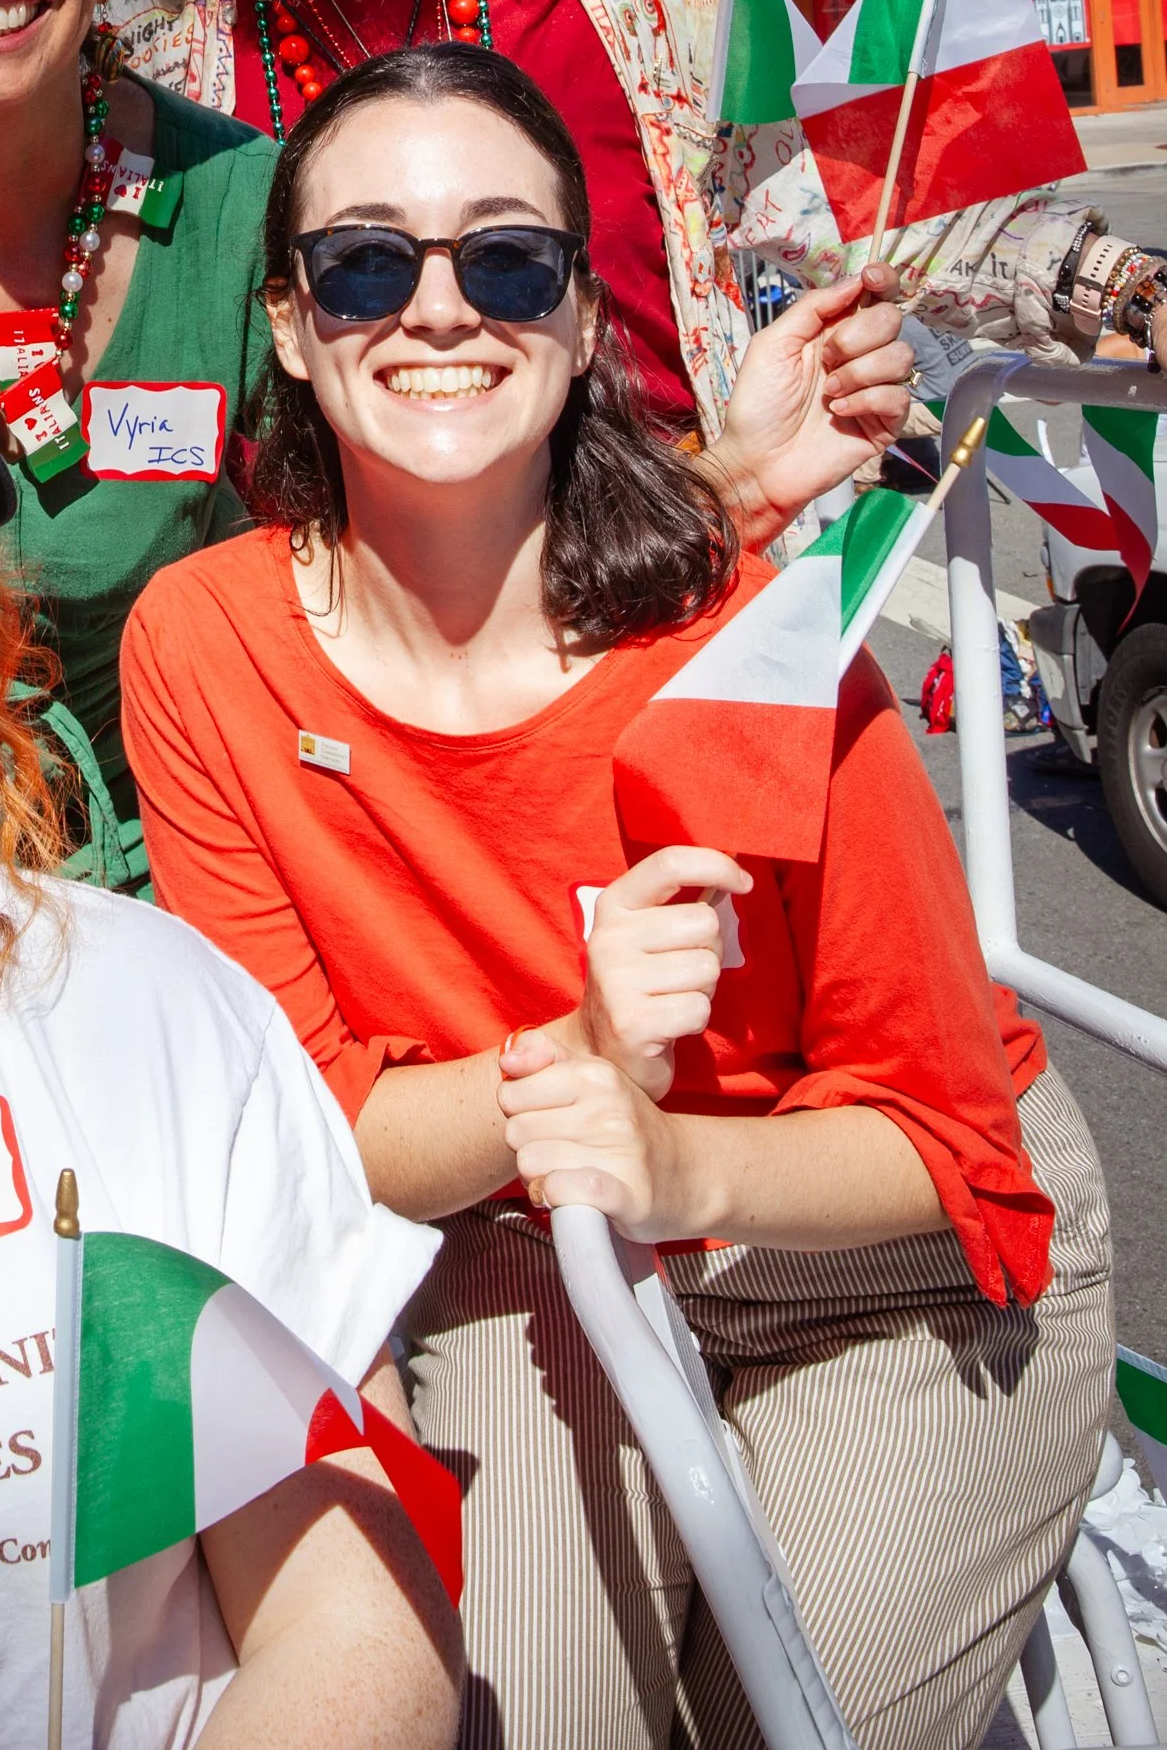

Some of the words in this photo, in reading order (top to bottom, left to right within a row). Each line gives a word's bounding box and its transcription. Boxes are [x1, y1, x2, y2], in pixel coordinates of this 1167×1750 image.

[13, 329, 29, 379] ITALIA
[107, 402, 174, 450] Vyria
[147, 446, 205, 467] ICS
